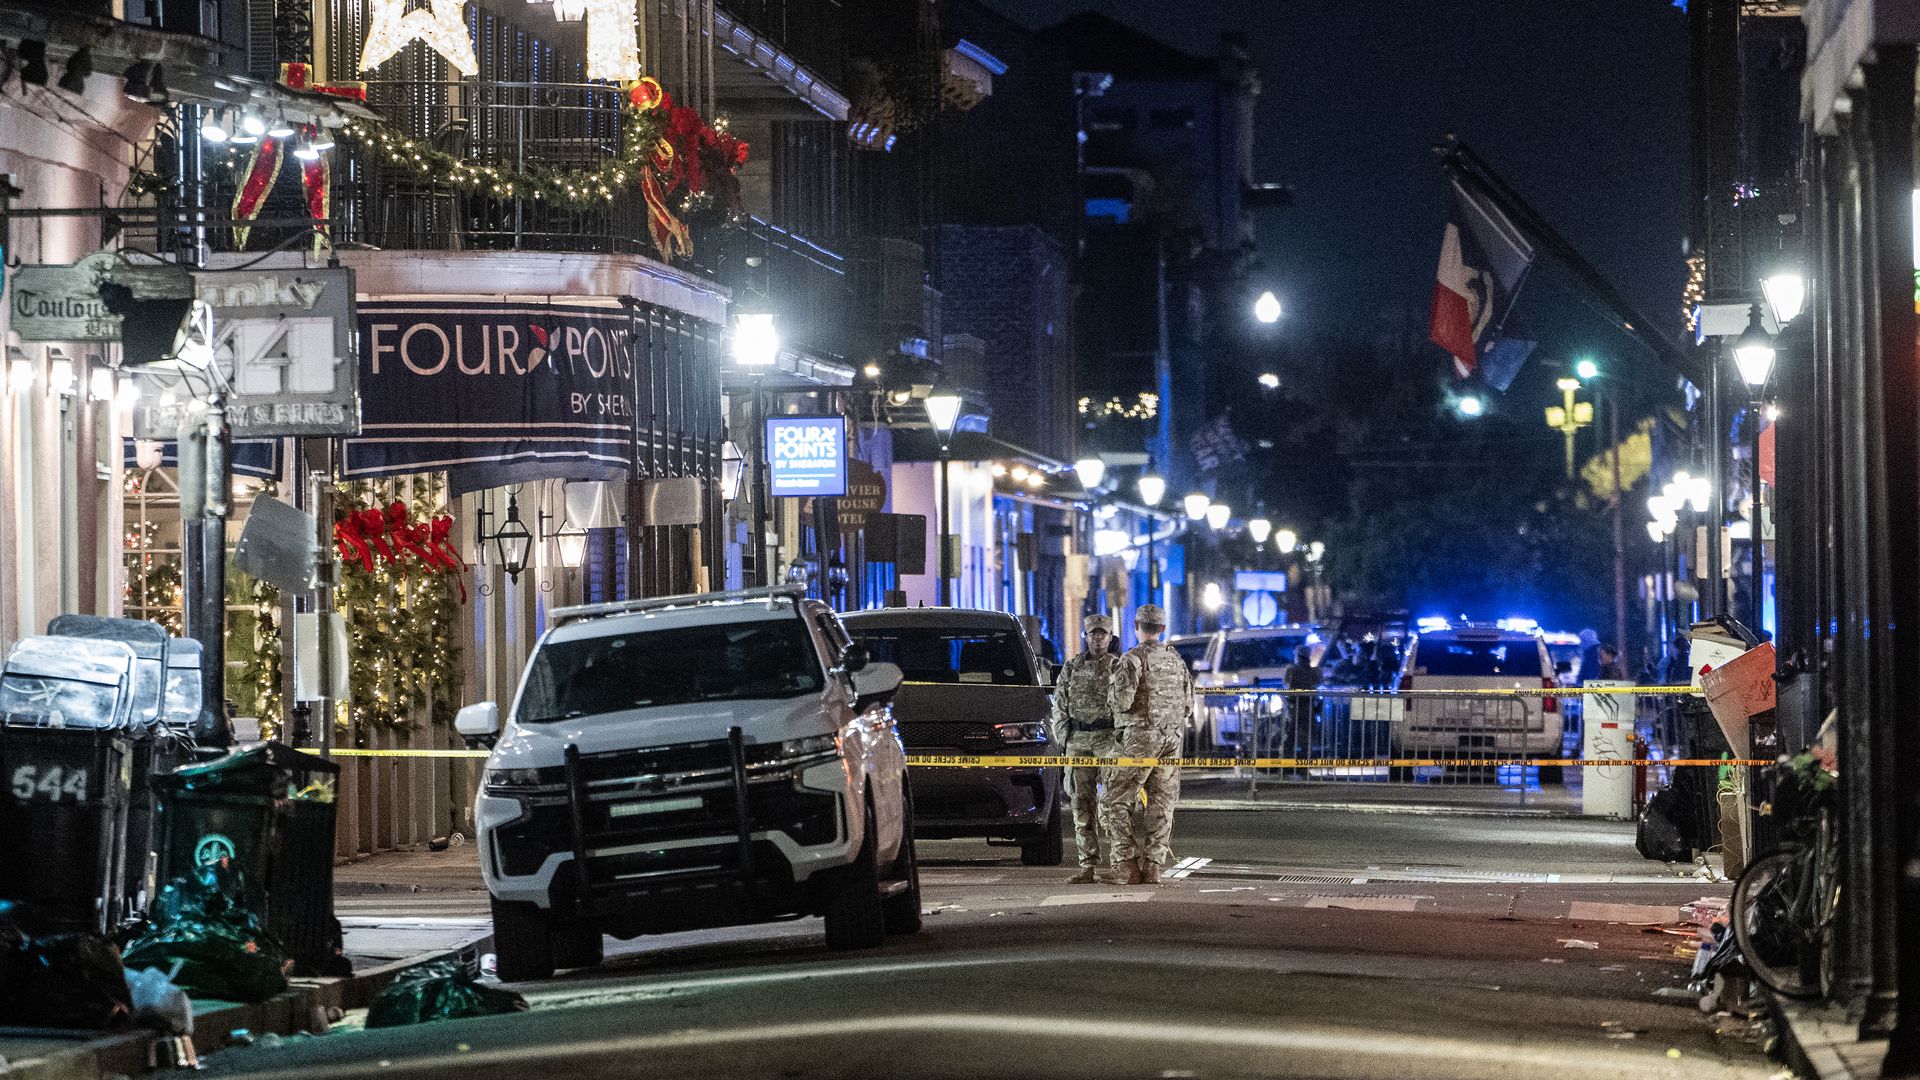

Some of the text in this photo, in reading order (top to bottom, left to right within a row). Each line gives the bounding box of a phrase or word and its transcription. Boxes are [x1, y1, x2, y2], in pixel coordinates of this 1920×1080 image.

[371, 322, 527, 376] FOUR
[571, 392, 592, 414] BY
[774, 427, 821, 442] FOUR
[774, 442, 837, 458] POINTS
[849, 484, 881, 496] VIER
[906, 756, 980, 764] CRIME SCENE DO NOT
[1019, 757, 1118, 765] CRIME SCENE DO NOT CROSS
[1157, 758, 1256, 766] CRIME SCENE DO NOT CROSS
[12, 765, 87, 801] 544
